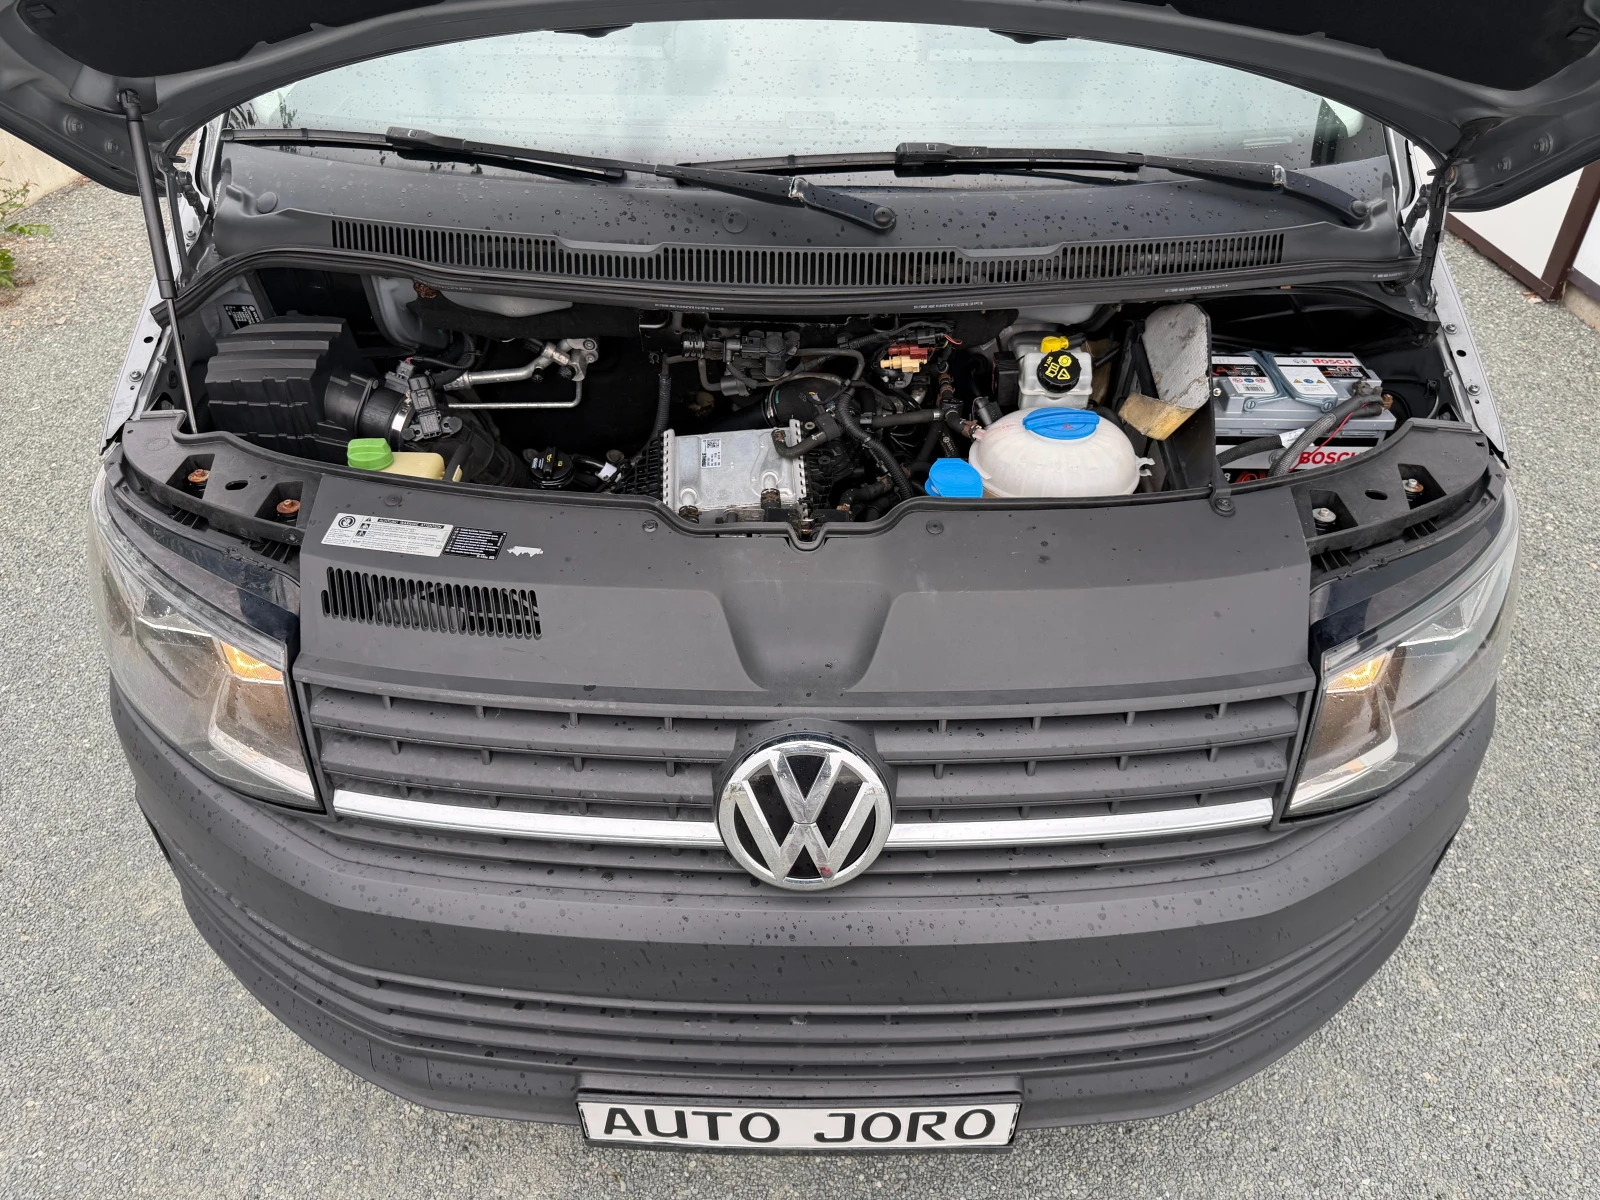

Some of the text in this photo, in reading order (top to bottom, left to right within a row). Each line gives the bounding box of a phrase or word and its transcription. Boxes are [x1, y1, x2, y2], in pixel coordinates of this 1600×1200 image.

[1299, 451, 1356, 465] BOSC
[603, 1107, 996, 1143] AUTO JORO
